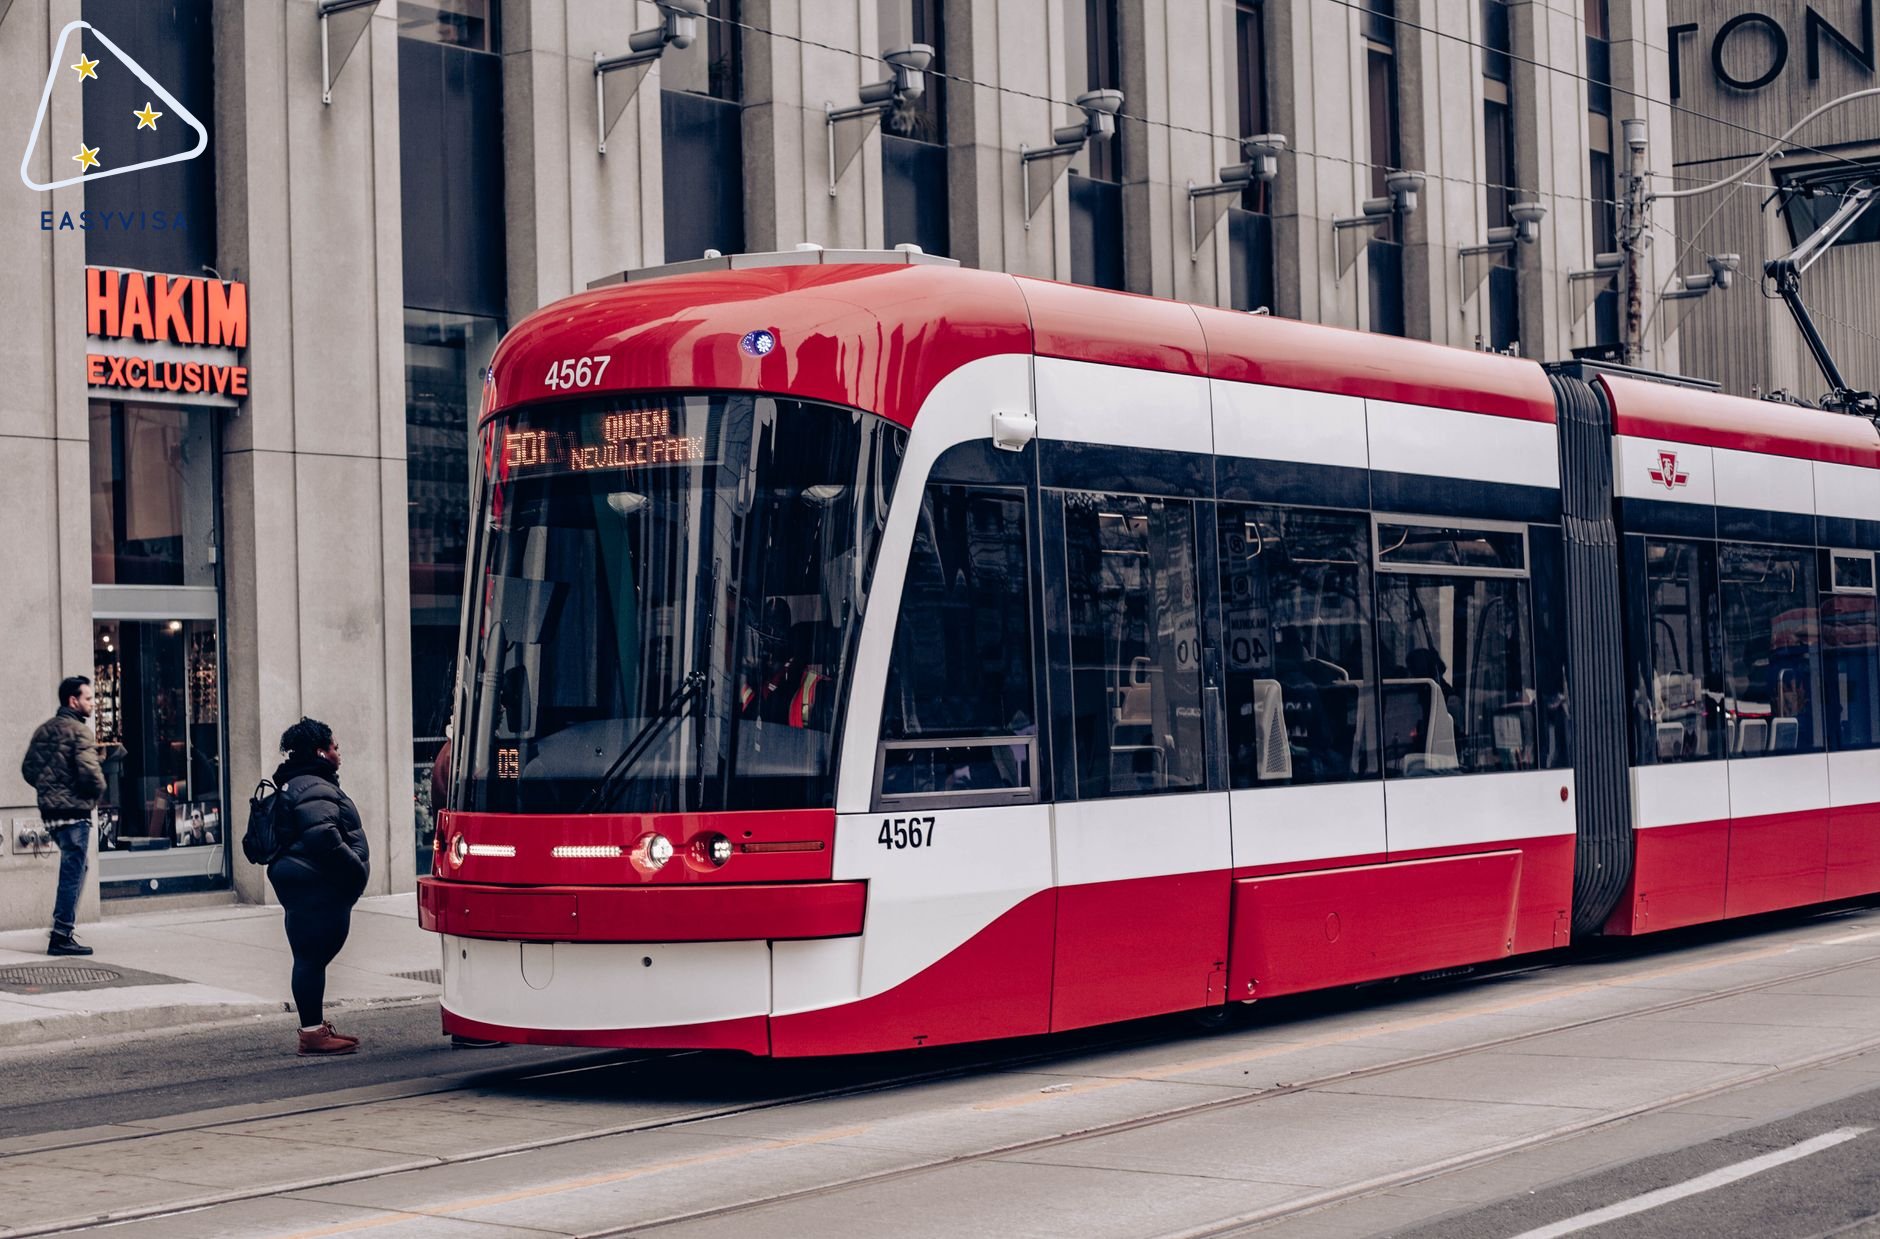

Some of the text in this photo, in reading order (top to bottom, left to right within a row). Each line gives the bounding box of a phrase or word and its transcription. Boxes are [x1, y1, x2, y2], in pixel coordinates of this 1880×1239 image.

[86, 266, 248, 348] HAKIM
[86, 354, 249, 397] EXCLUSIVE
[544, 355, 611, 391] 4567
[604, 408, 668, 442] QUEEN
[505, 430, 546, 467] 501
[571, 436, 703, 471] NEVILLE PARK
[498, 748, 519, 779] 09
[877, 816, 936, 850] 4567
